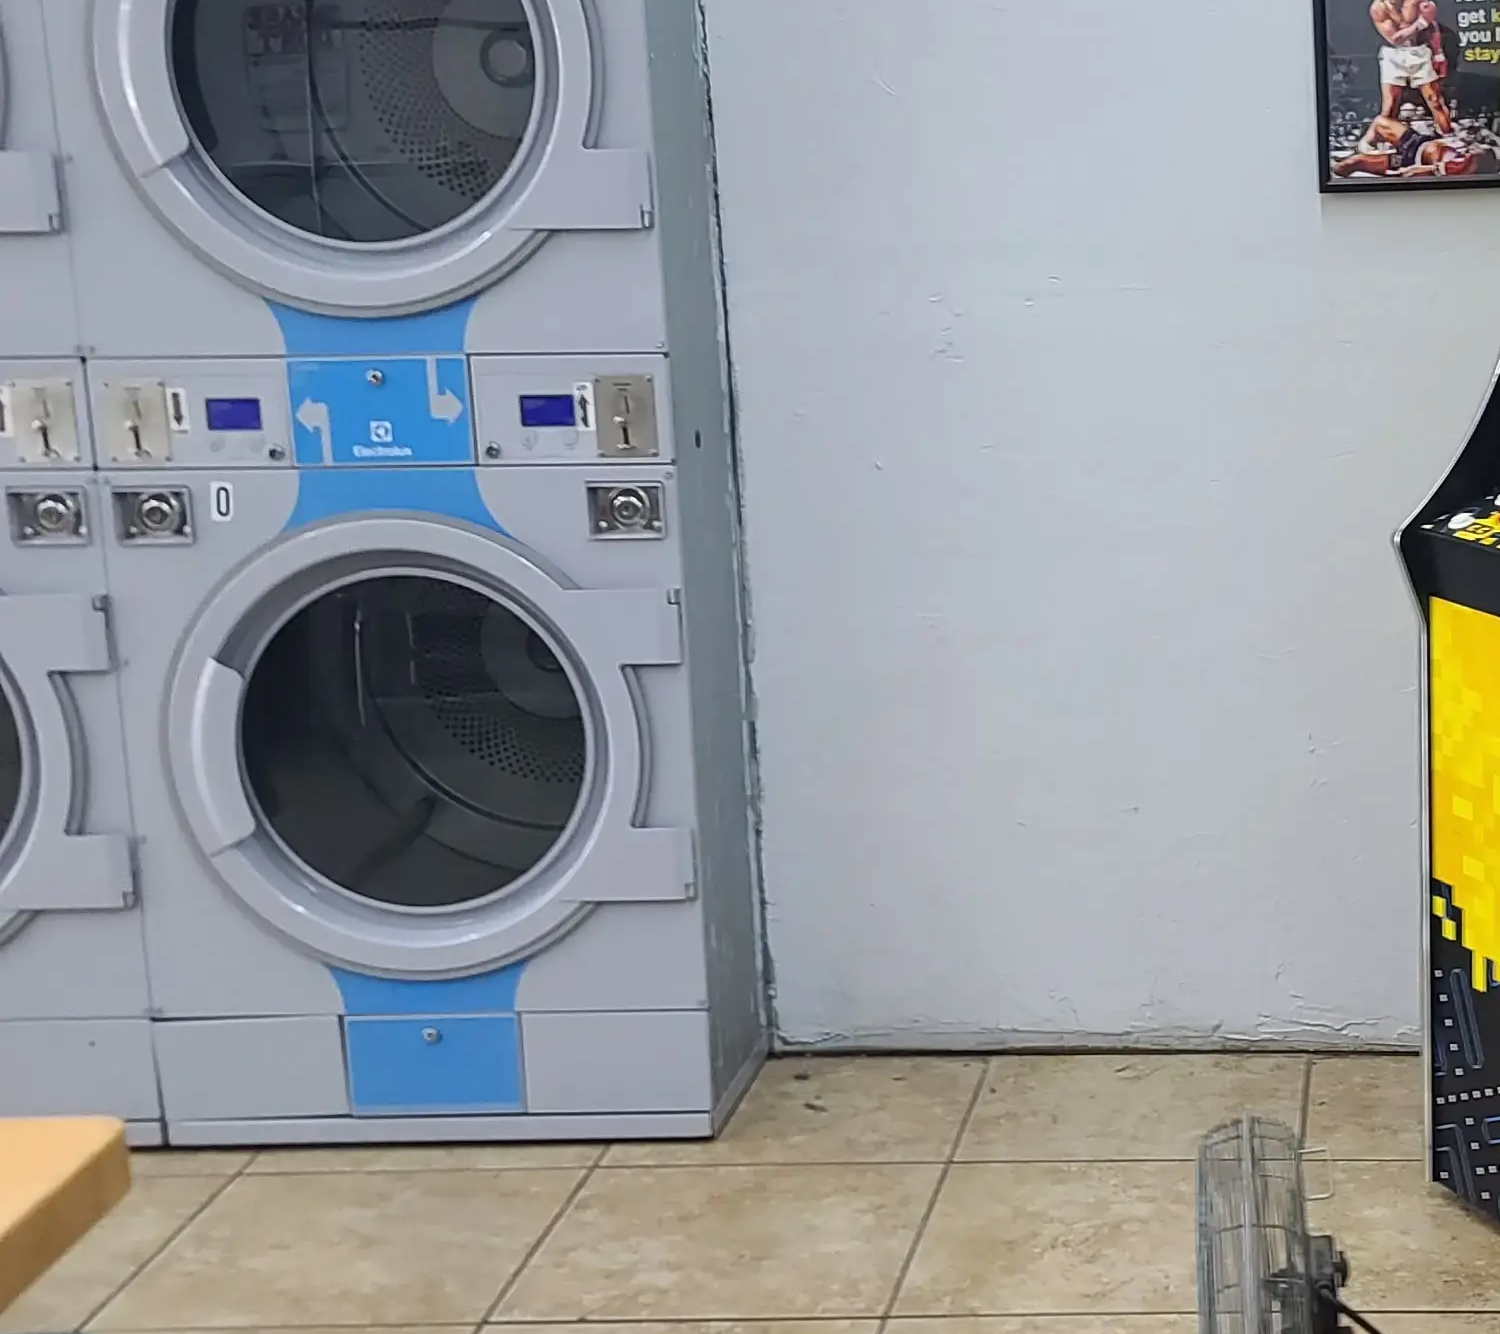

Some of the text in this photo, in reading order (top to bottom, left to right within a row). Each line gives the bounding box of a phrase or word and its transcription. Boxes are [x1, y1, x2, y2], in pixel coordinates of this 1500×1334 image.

[1457, 9, 1487, 27] get
[1459, 30, 1491, 46] you
[1464, 47, 1500, 63] stay
